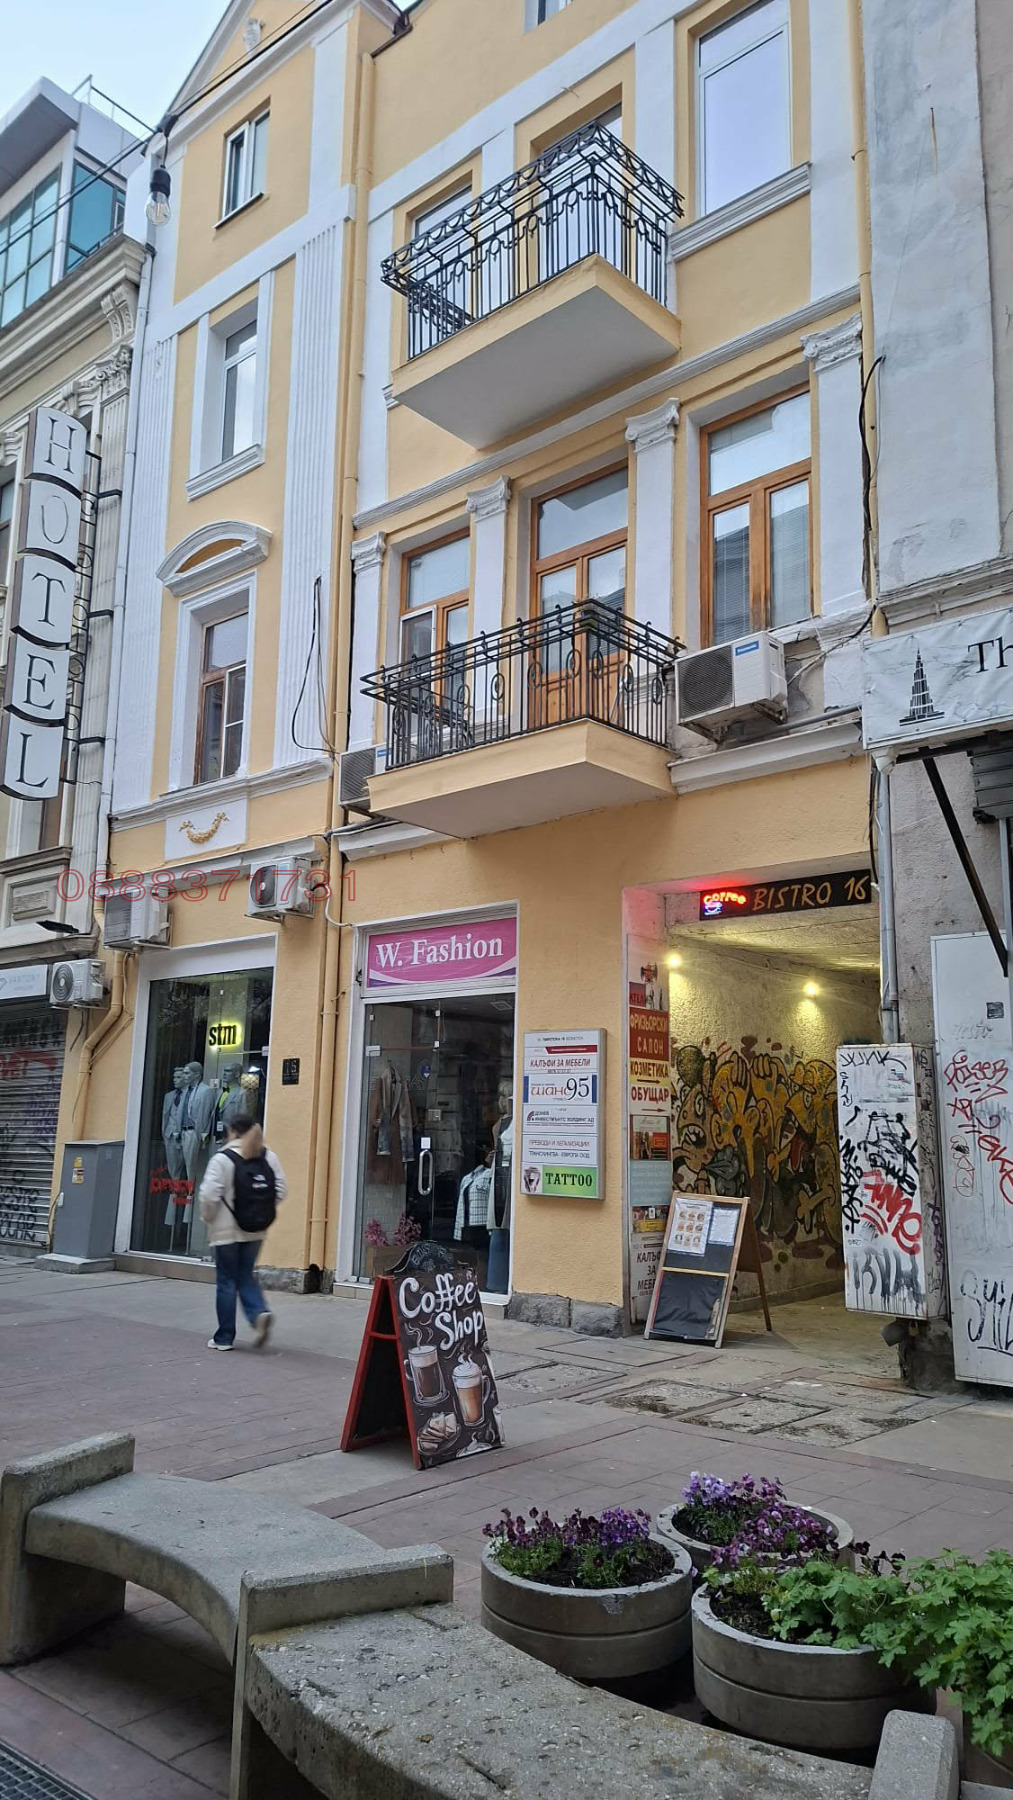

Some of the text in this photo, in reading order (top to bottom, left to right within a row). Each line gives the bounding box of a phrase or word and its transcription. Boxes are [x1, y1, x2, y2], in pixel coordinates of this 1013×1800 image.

[16, 415, 75, 788] HOTEL
[752, 875, 870, 912] BISTRO 16
[376, 933, 505, 969] W. Fashion
[209, 1023, 237, 1047] stm
[637, 1036, 664, 1055] САЛОН
[530, 1058, 591, 1068] КАЛЪФИ ЗА МЕБЕЛИ
[630, 1061, 669, 1078] КОЗМЕТИКА
[631, 1086, 670, 1104] ОБУЩАР
[545, 1172, 593, 1187] TATTOO
[637, 1251, 661, 1262] КАЛЪФ
[647, 1265, 656, 1275] ЗА
[399, 1272, 478, 1320] Coffee
[434, 1310, 484, 1351] Shop
